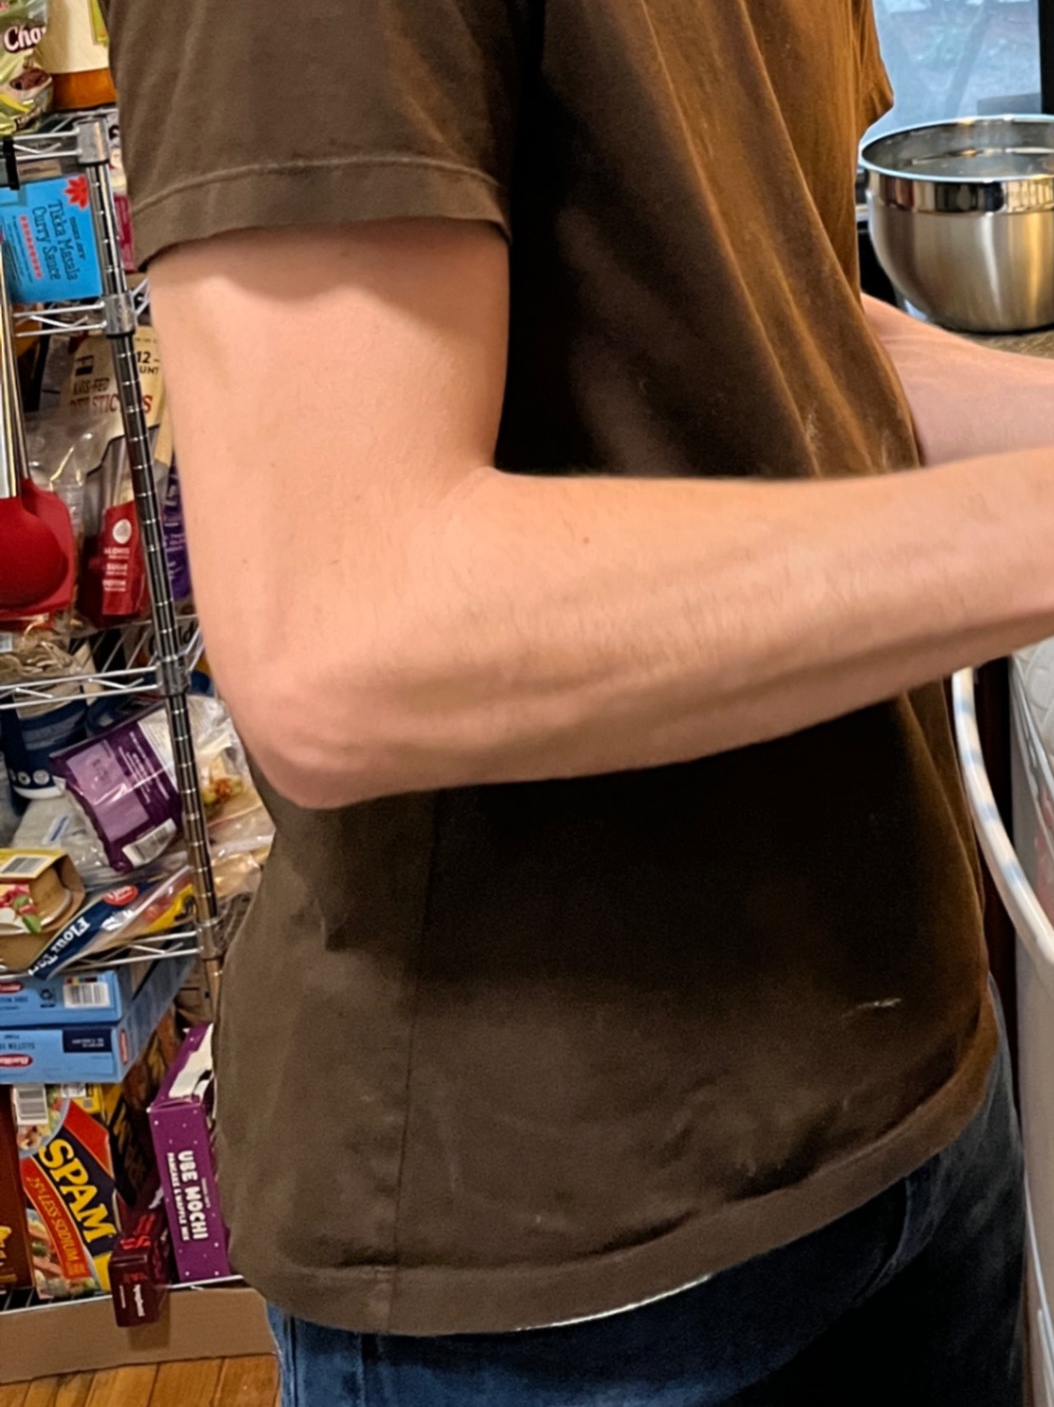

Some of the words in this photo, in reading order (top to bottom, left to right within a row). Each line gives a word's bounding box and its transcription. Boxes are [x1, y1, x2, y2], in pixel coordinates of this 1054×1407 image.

[32, 206, 52, 243] Curry
[43, 246, 62, 281] Sauce
[47, 200, 66, 237] Tikka
[58, 238, 80, 281] Masala
[52, 916, 91, 954] Flour
[38, 1138, 117, 1243] SPAM
[177, 1150, 199, 1182] UBE
[37, 1192, 59, 1222] LESS
[51, 1217, 80, 1262] SODIUM
[184, 1186, 209, 1240] MOCHI
